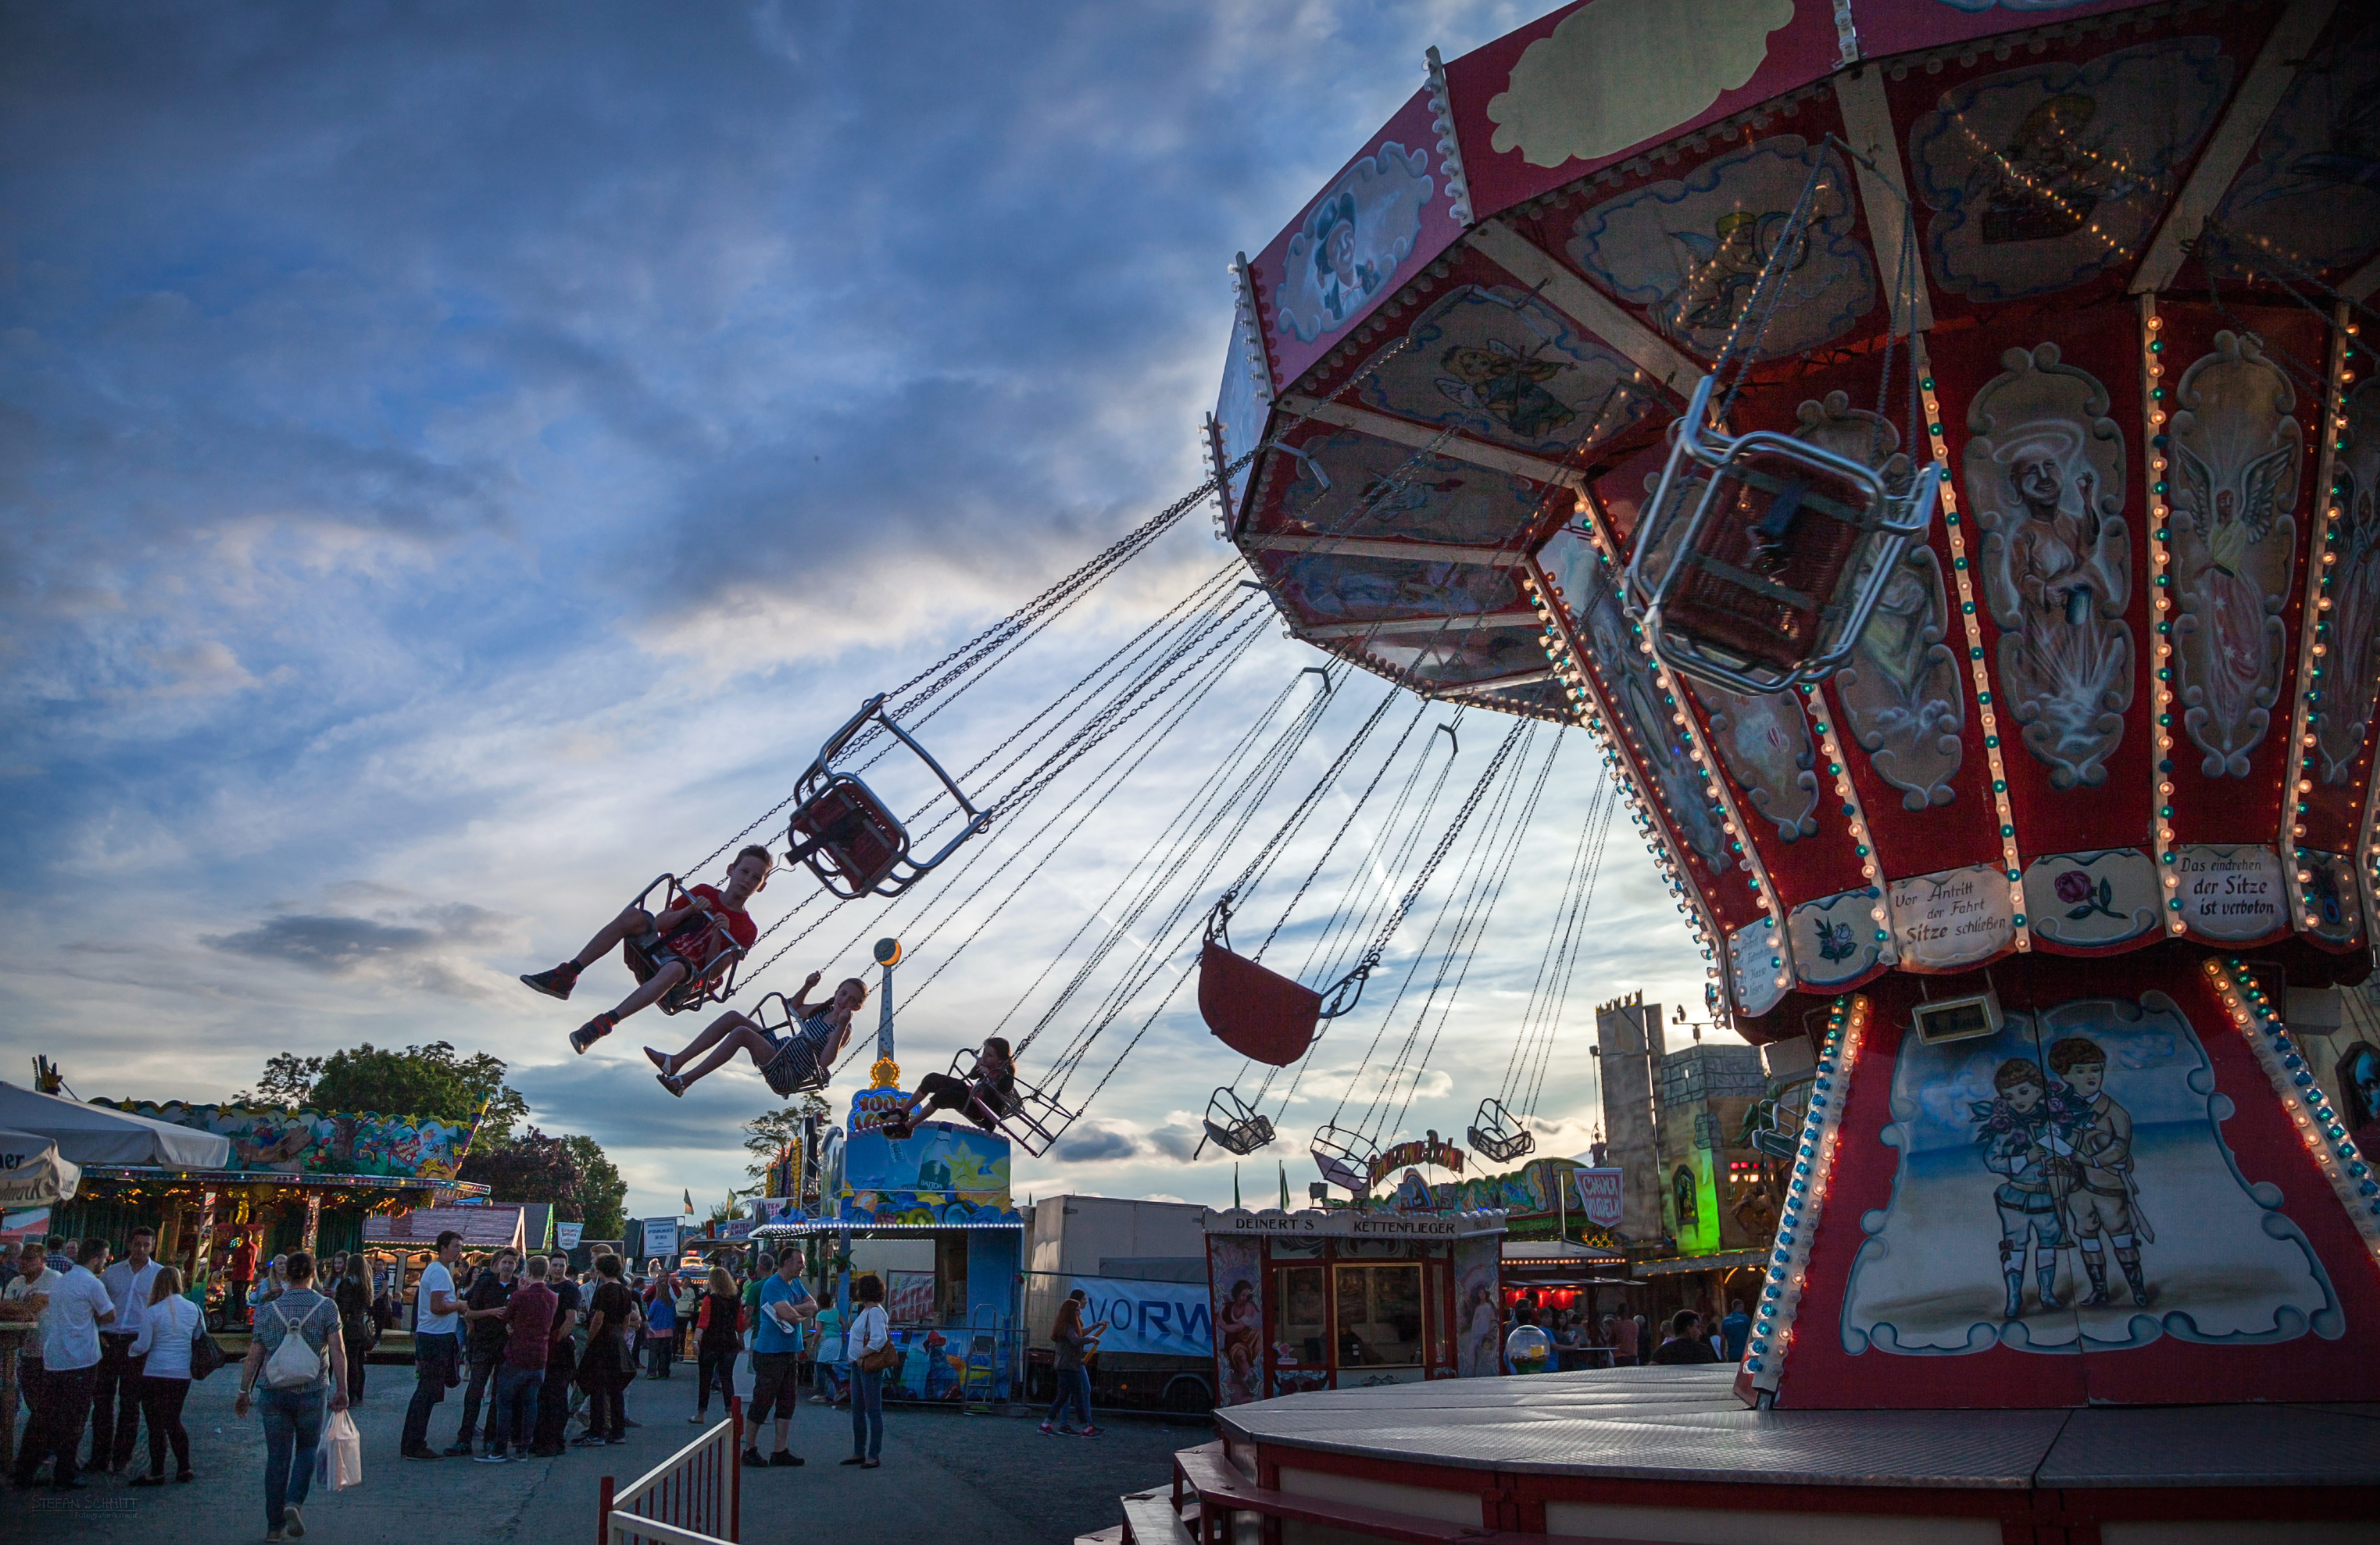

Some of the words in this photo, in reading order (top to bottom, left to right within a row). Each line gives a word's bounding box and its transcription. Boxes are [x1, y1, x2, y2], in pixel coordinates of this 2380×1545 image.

[2180, 857, 2206, 872] Das
[2211, 858, 2262, 871] eindrehen
[2193, 878, 2219, 894] der
[2225, 874, 2267, 894] Sitze
[1896, 893, 1917, 907] Vor
[1927, 882, 1974, 901] Antritt
[1927, 908, 1944, 919] der
[1950, 898, 1985, 915] Fahrt
[2200, 898, 2217, 915] ist
[1906, 923, 1948, 944] Sitze
[1955, 916, 2005, 936] schließen
[1353, 1221, 1455, 1234] KETTENFLIEGER
[1474, 1220, 1491, 1230] HAGEN
[901, 1277, 930, 1289] Lustige
